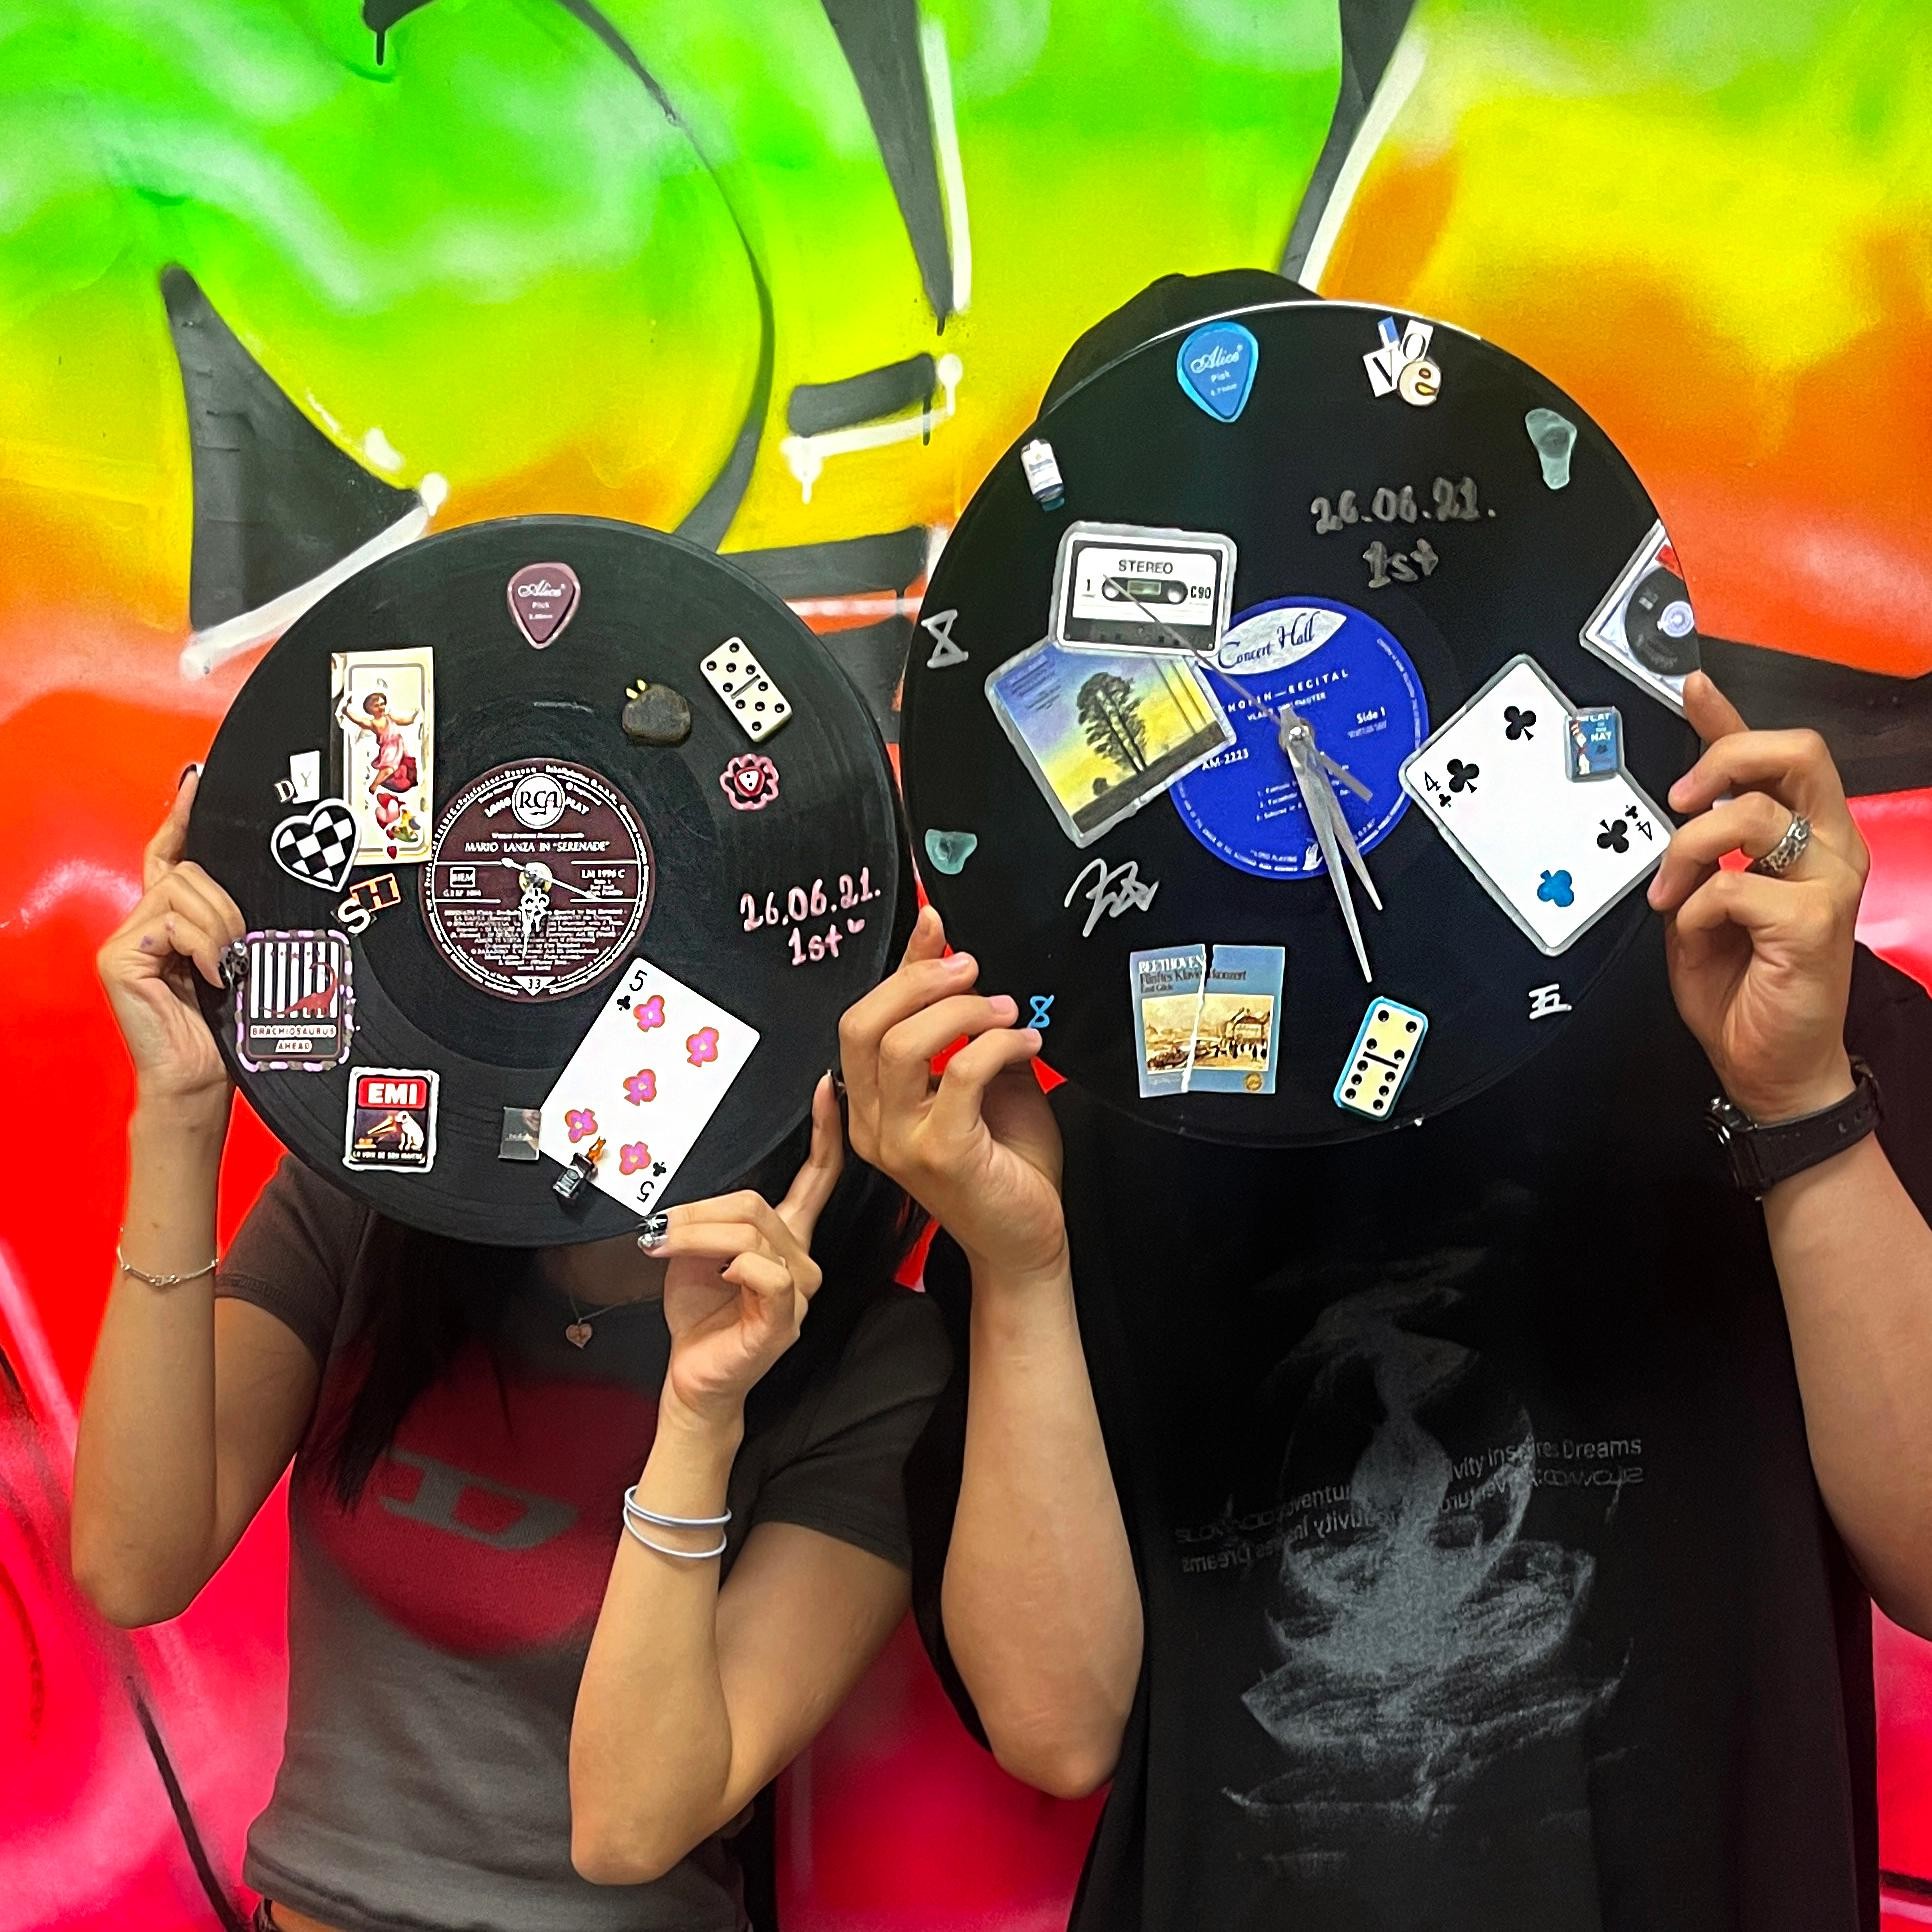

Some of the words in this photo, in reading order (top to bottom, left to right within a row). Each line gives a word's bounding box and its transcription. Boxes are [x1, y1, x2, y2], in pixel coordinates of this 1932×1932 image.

[1118, 560, 1173, 574] STEREO
[1362, 538, 1439, 588] 1st
[1218, 640, 1275, 669] Concert
[1277, 611, 1321, 649] Hall
[1356, 709, 1378, 724] Side
[1424, 771, 1441, 791] 4
[518, 790, 560, 815] RCA
[1635, 821, 1653, 841] 4
[465, 842, 498, 852] MARIO
[503, 842, 536, 852] LANZA
[539, 841, 551, 852] IN
[739, 866, 881, 932] 26.06.21.
[788, 923, 844, 966] 1st
[629, 970, 648, 992] 5
[1028, 994, 1055, 1029] 8
[251, 1026, 336, 1037] BRACHIOSAURUS
[278, 1042, 312, 1051] AHEAD
[368, 1083, 418, 1105] EMI
[636, 1181, 655, 1202] 5
[1563, 1438, 1642, 1459] Dreams
